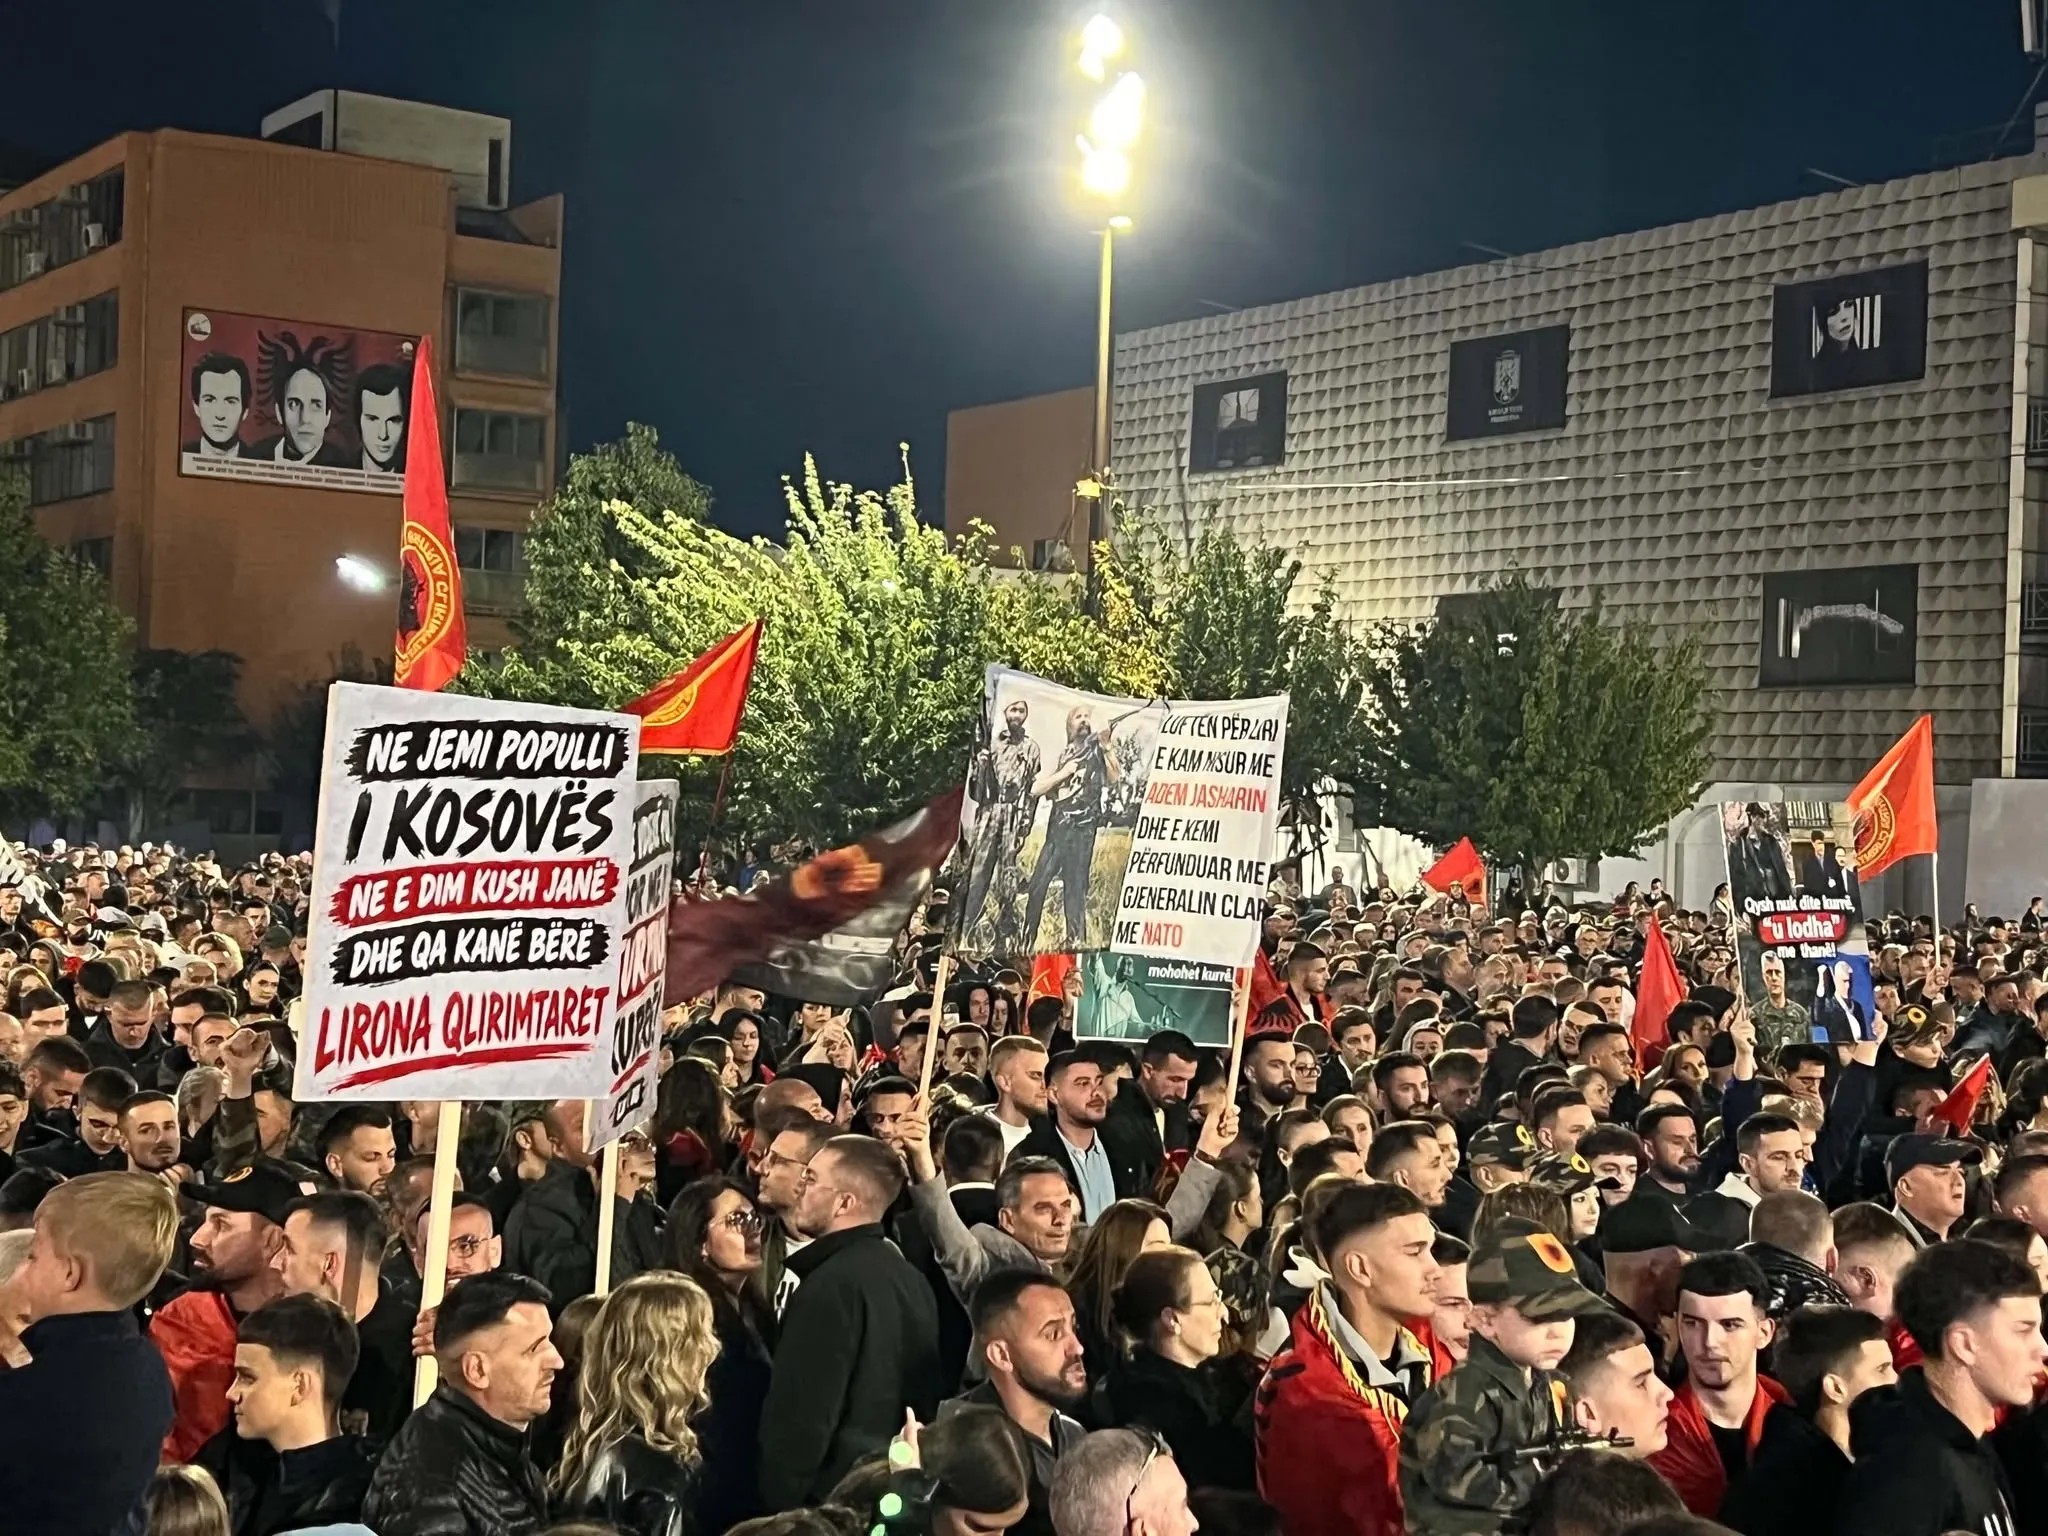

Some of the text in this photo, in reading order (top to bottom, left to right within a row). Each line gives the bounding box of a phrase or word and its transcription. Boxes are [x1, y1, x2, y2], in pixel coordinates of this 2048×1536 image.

[1221, 712, 1250, 740] PËR
[366, 727, 615, 774] NE JEMI POPULLI
[1154, 746, 1167, 770] E
[1167, 747, 1204, 772] KAM
[1248, 752, 1276, 778] ME
[1144, 782, 1267, 813] ADEM JASHARIN
[344, 788, 373, 865] I
[382, 779, 618, 865] KOSOVËS
[1137, 816, 1220, 843] DHE E KEMI
[1128, 847, 1267, 886] PËRFUNDUAR ME
[348, 879, 389, 920] NE
[393, 875, 413, 913] E
[416, 870, 467, 908] DIM
[471, 866, 540, 905] KUSH
[542, 858, 610, 904] JANË
[1122, 885, 1217, 916] GJENERALIN
[1744, 896, 1774, 916] Qysh
[1775, 894, 1799, 911] nuk
[1115, 920, 1184, 948] ME NATO
[349, 935, 406, 979] DHE
[410, 927, 447, 971] QA
[453, 921, 524, 964] KANË
[527, 921, 594, 963] BËRË
[1777, 945, 1796, 958] me
[1148, 962, 1200, 980] mohohet
[314, 985, 610, 1077] LIRONA QLIRIMTARET
